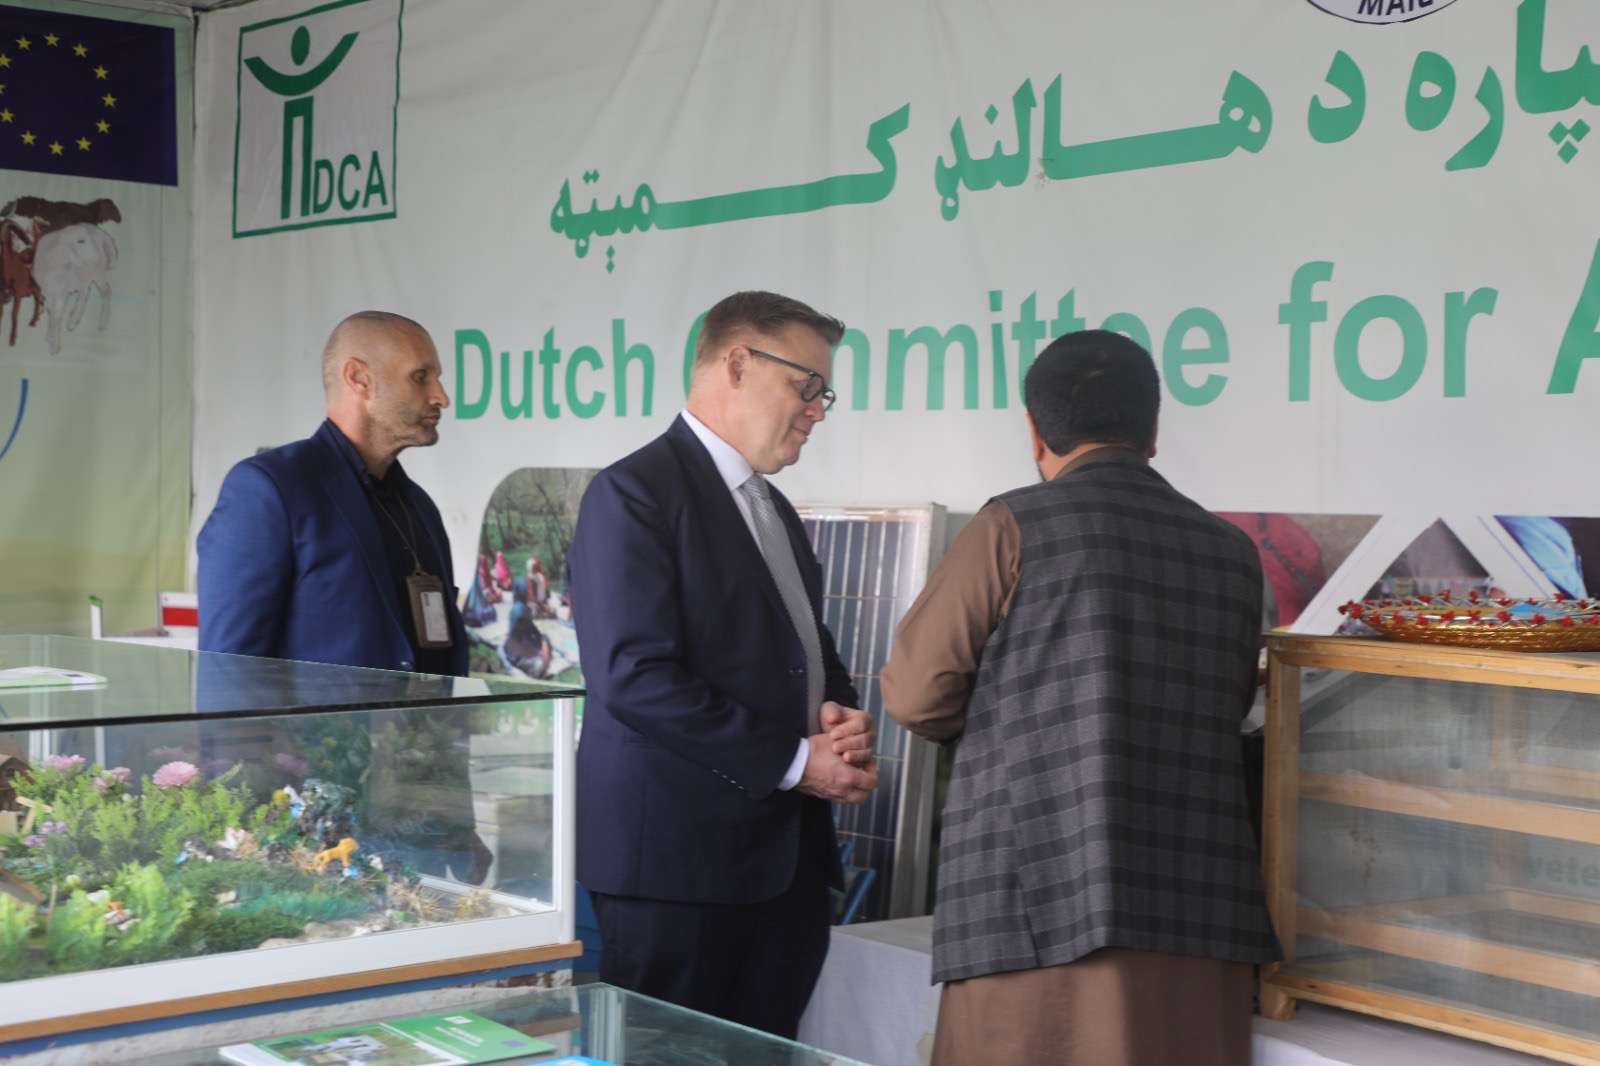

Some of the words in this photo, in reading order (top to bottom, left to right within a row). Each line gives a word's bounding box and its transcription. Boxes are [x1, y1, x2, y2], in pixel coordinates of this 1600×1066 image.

[1357, 0, 1433, 16] MAI
[1307, 49, 1366, 144] د
[1405, 0, 1600, 172] پاره
[312, 150, 388, 215] DCA
[454, 318, 656, 421] Dutch
[682, 286, 1230, 412] mitte
[1277, 259, 1500, 403] for
